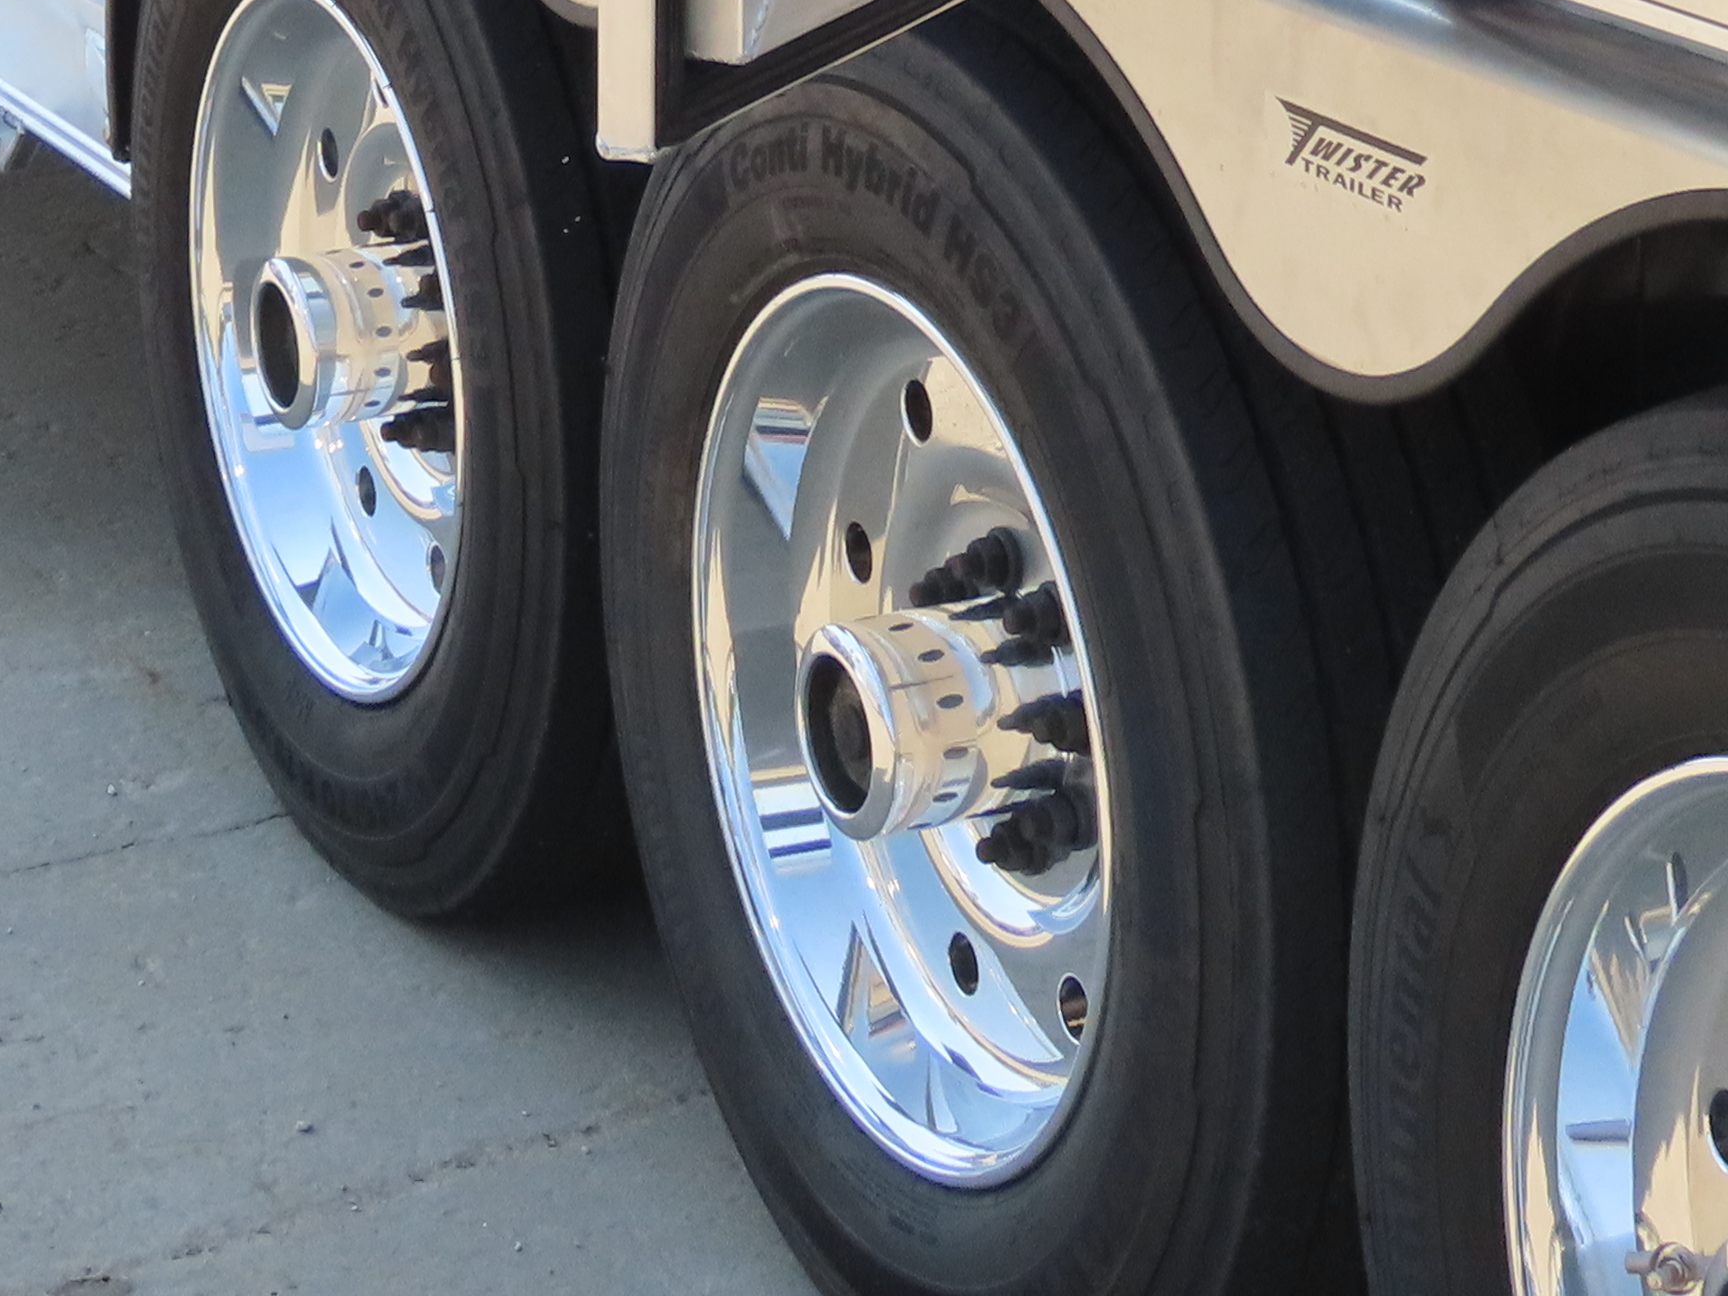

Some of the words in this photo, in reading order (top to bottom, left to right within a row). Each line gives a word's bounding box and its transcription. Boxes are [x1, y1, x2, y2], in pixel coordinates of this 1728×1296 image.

[1273, 94, 1429, 198] TWISTER
[1300, 156, 1404, 214] TRAILER
[729, 121, 809, 193] Conti
[821, 123, 940, 239] Hybrid
[944, 213, 1021, 341] HS3
